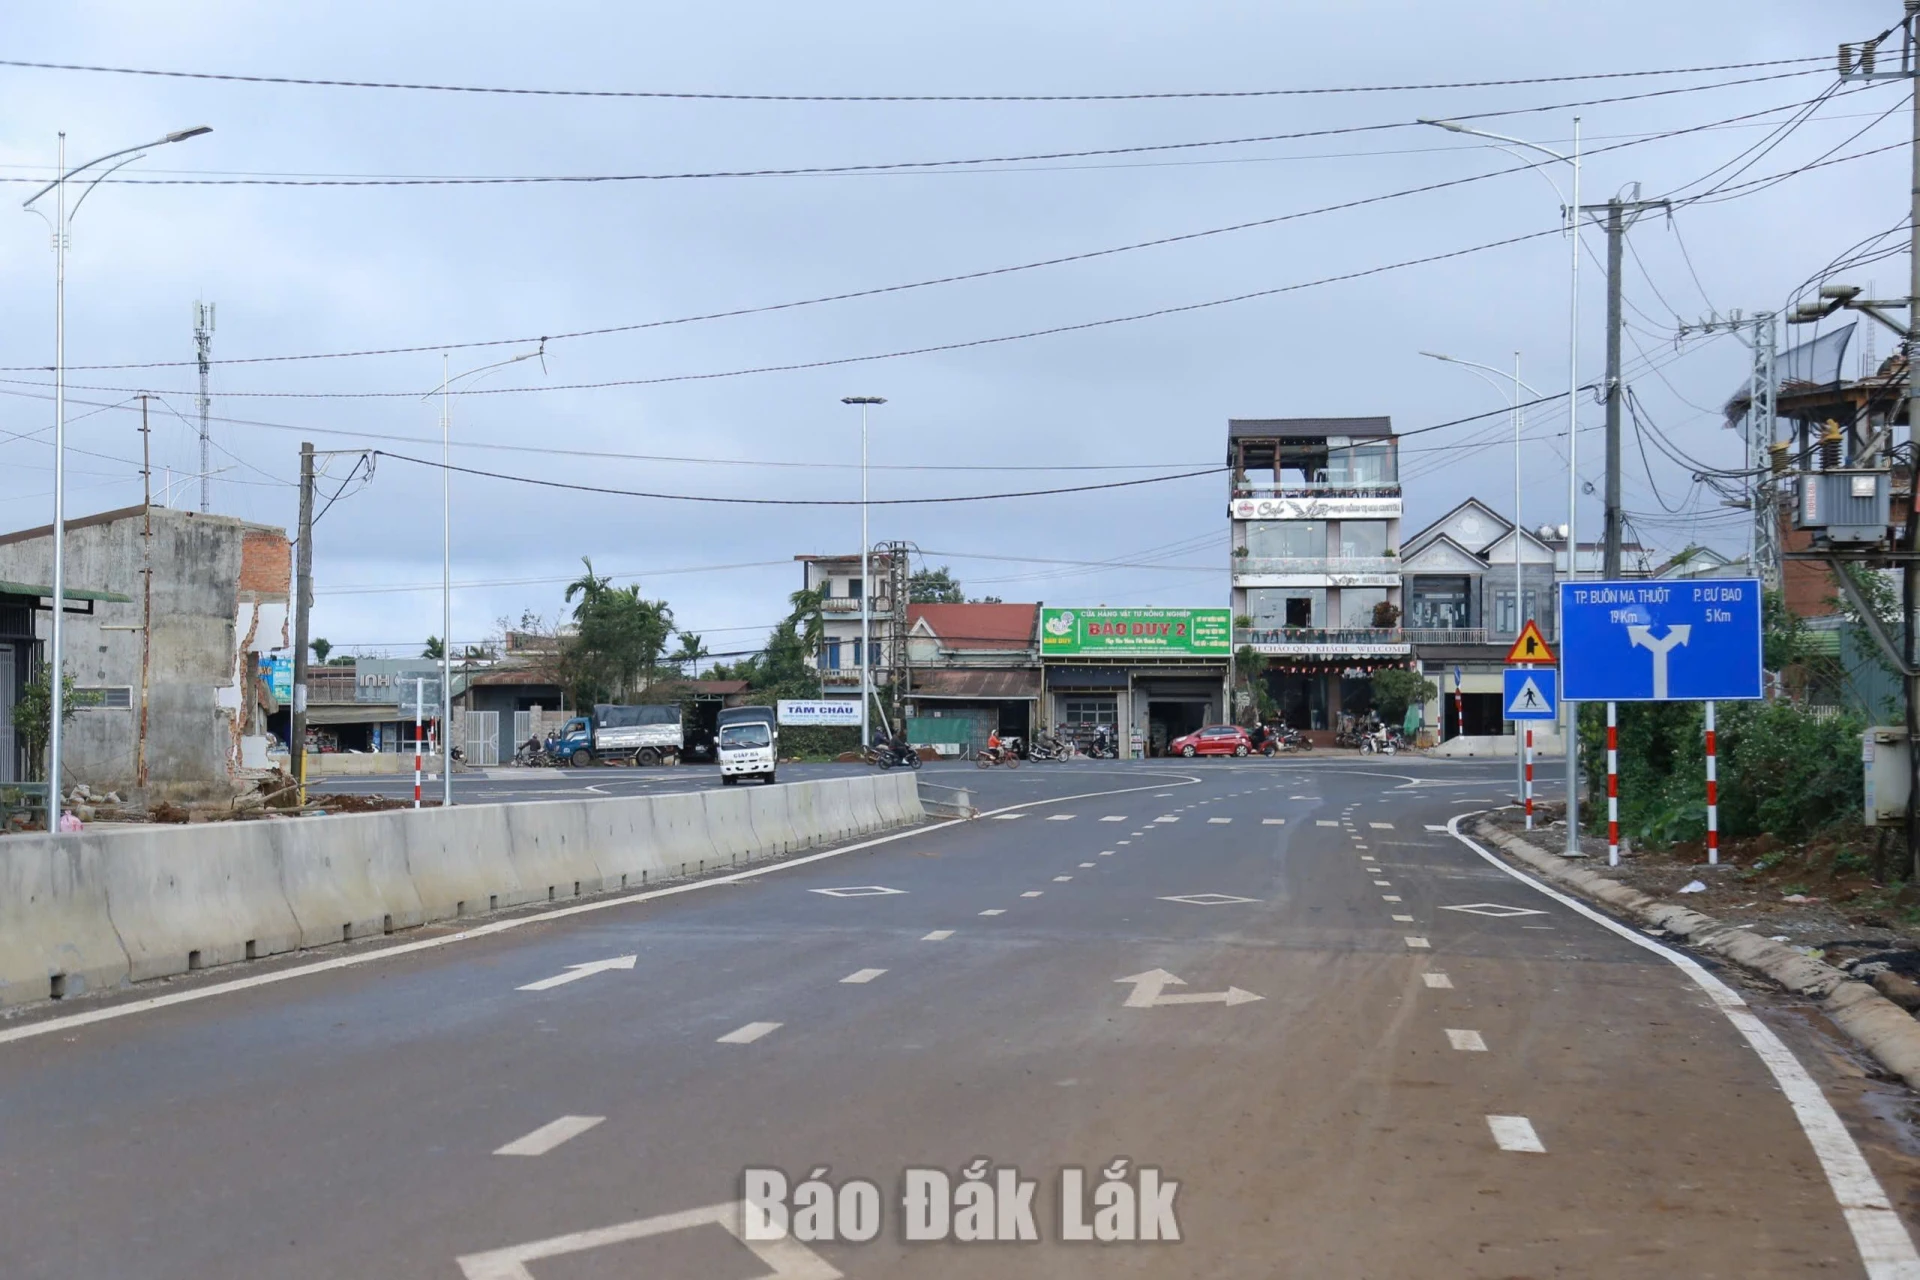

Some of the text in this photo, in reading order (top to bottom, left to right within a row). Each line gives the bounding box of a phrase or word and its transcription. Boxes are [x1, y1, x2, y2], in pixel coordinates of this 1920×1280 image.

[1574, 587, 1671, 604] TP. BUÔN MA THUỘT
[1721, 588, 1742, 601] BAO
[1097, 609, 1118, 617] HÀNG
[1610, 610, 1638, 623] 19 Km
[1706, 609, 1731, 622] 5 Km
[1132, 622, 1170, 636] DUY
[1176, 623, 1186, 636] 2
